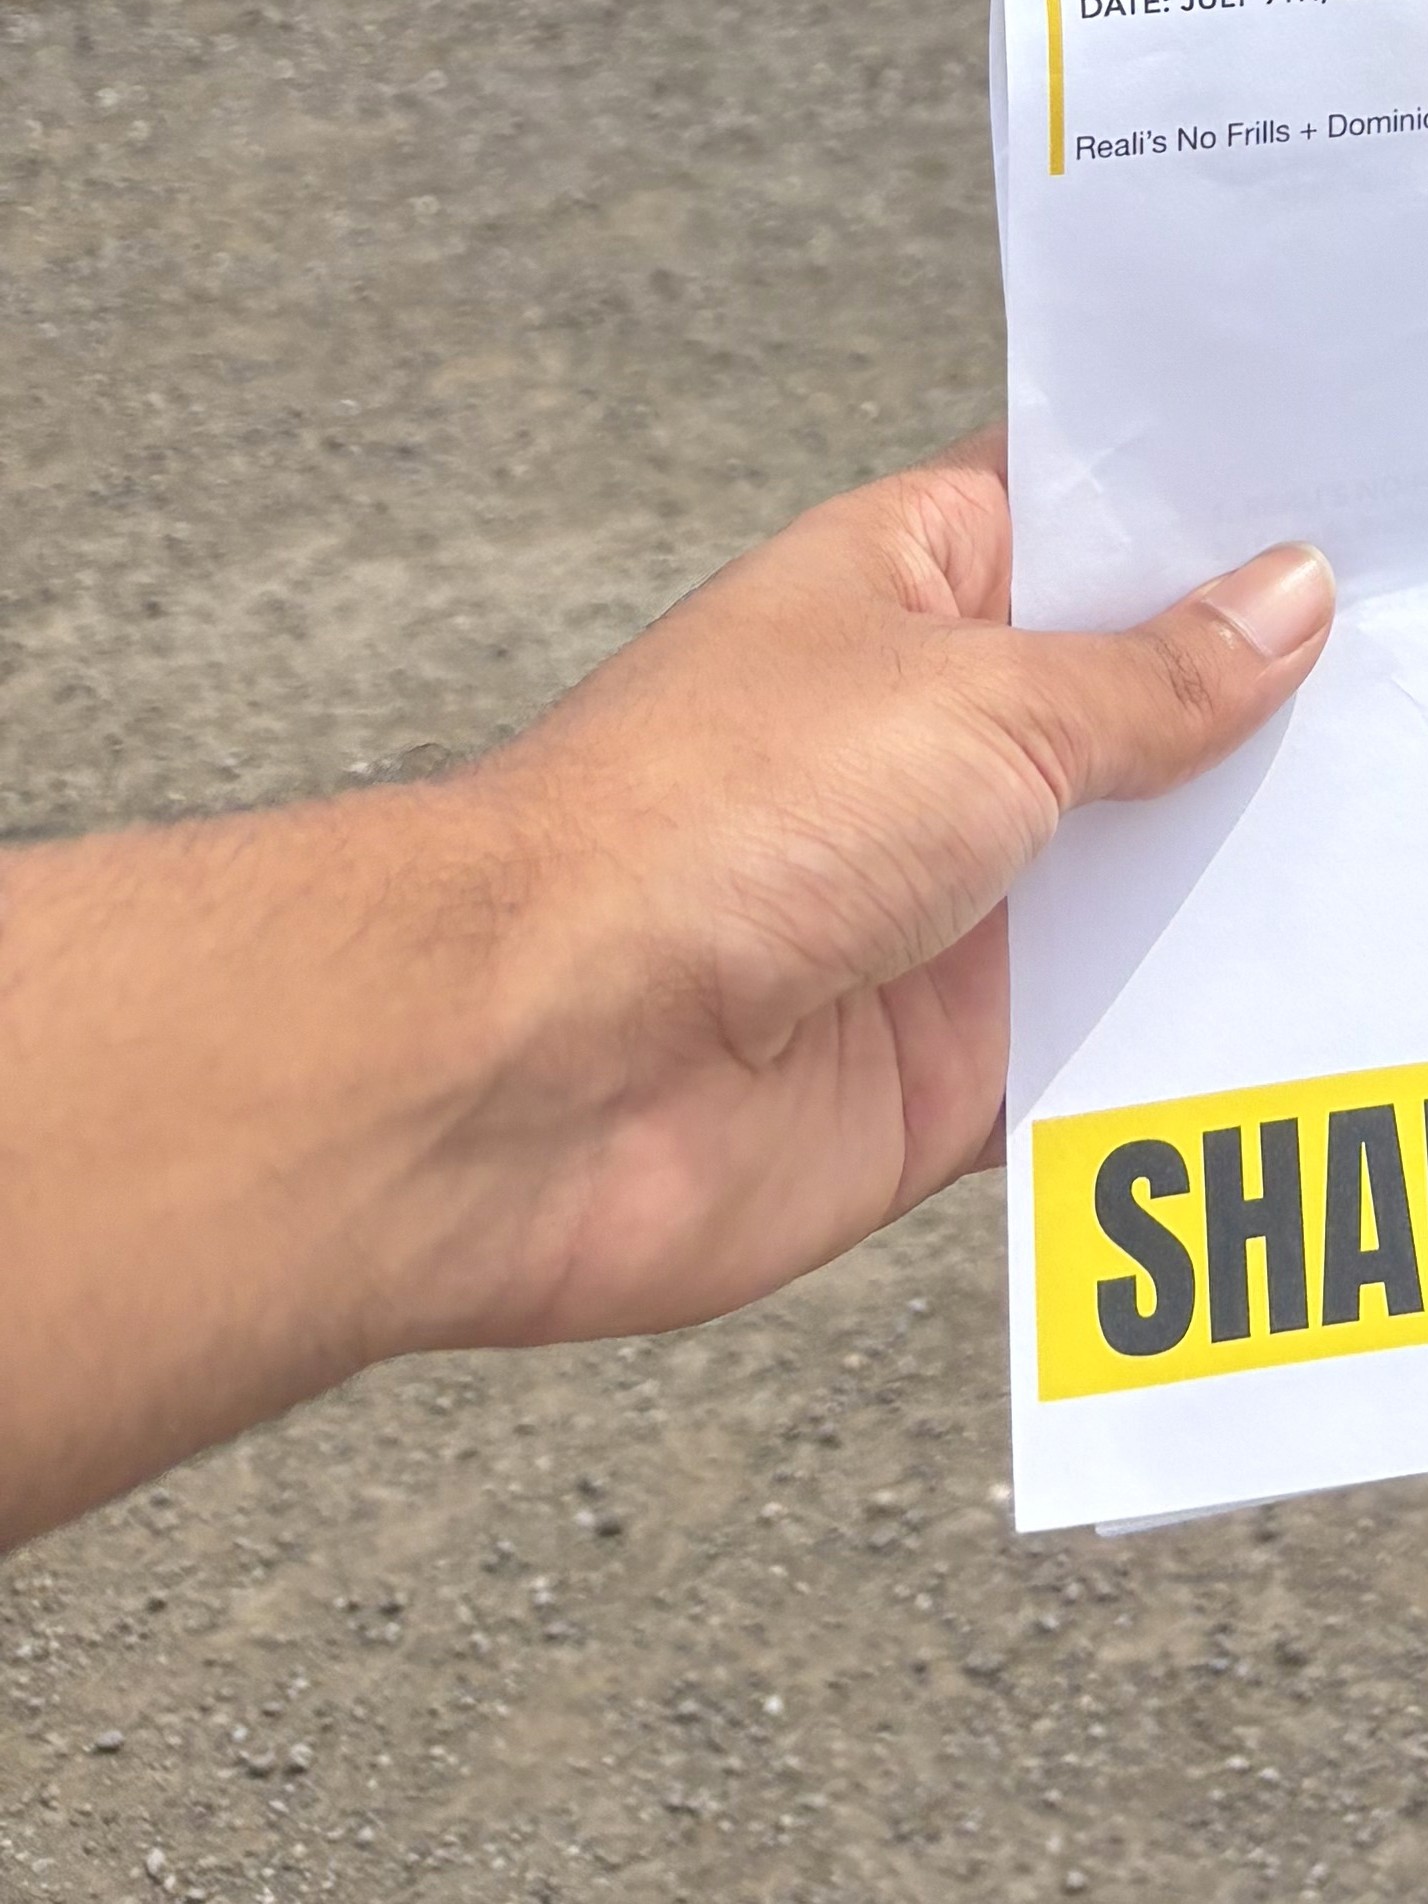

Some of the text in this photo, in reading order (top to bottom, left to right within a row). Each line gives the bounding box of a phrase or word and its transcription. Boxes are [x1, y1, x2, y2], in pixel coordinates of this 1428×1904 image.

[1076, 130, 1167, 161] Reali’s
[1177, 126, 1217, 152] No
[1227, 119, 1290, 148] Frills
[1300, 122, 1318, 141] +
